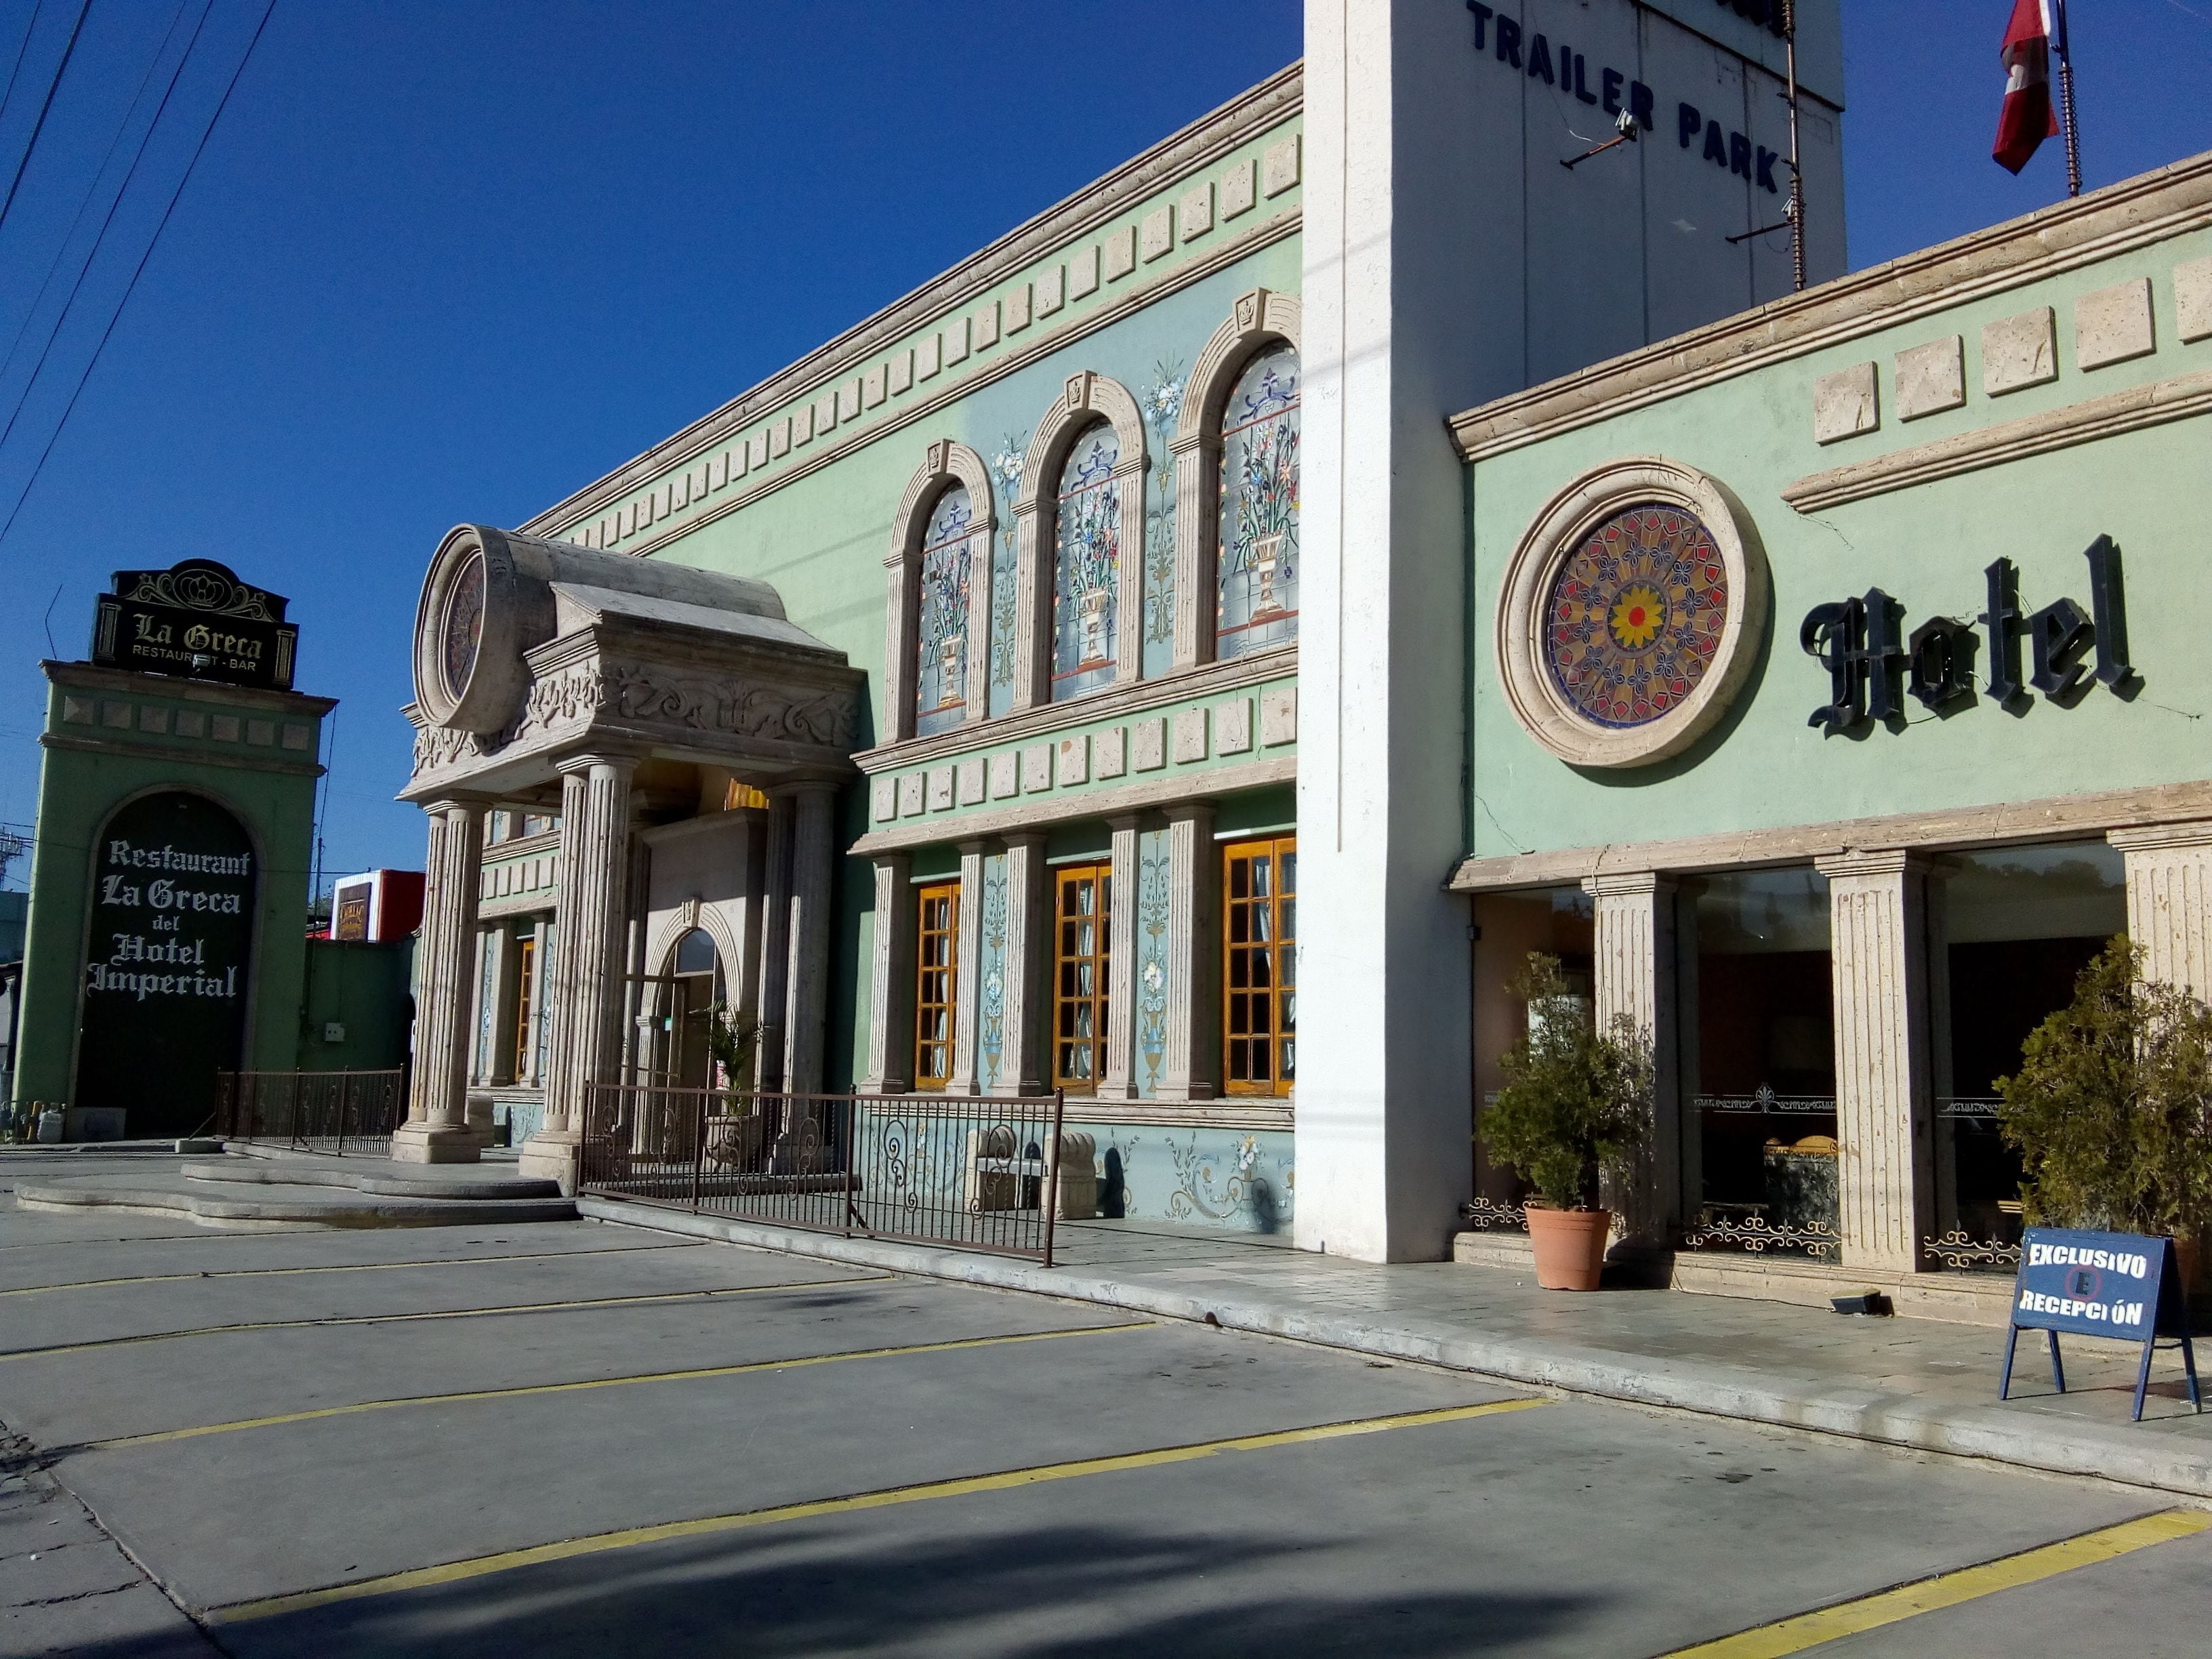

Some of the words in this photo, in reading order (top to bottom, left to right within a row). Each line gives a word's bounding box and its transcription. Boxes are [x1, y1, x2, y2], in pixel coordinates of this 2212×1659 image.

[1467, 0, 1654, 131] TRAILER
[1679, 102, 1778, 193] PARK
[134, 613, 172, 644] La
[184, 624, 262, 659] Greca
[1800, 533, 2136, 726] Hotel
[133, 645, 218, 665] RESTAURT
[230, 659, 256, 671] BAR
[109, 840, 249, 876] Restaurant
[102, 875, 140, 907] La
[148, 879, 241, 914] Greca
[152, 916, 180, 931] del
[110, 933, 205, 966] Hotel
[86, 963, 237, 1002] Imperial
[2028, 1243, 2147, 1279] EXCLUSIVO
